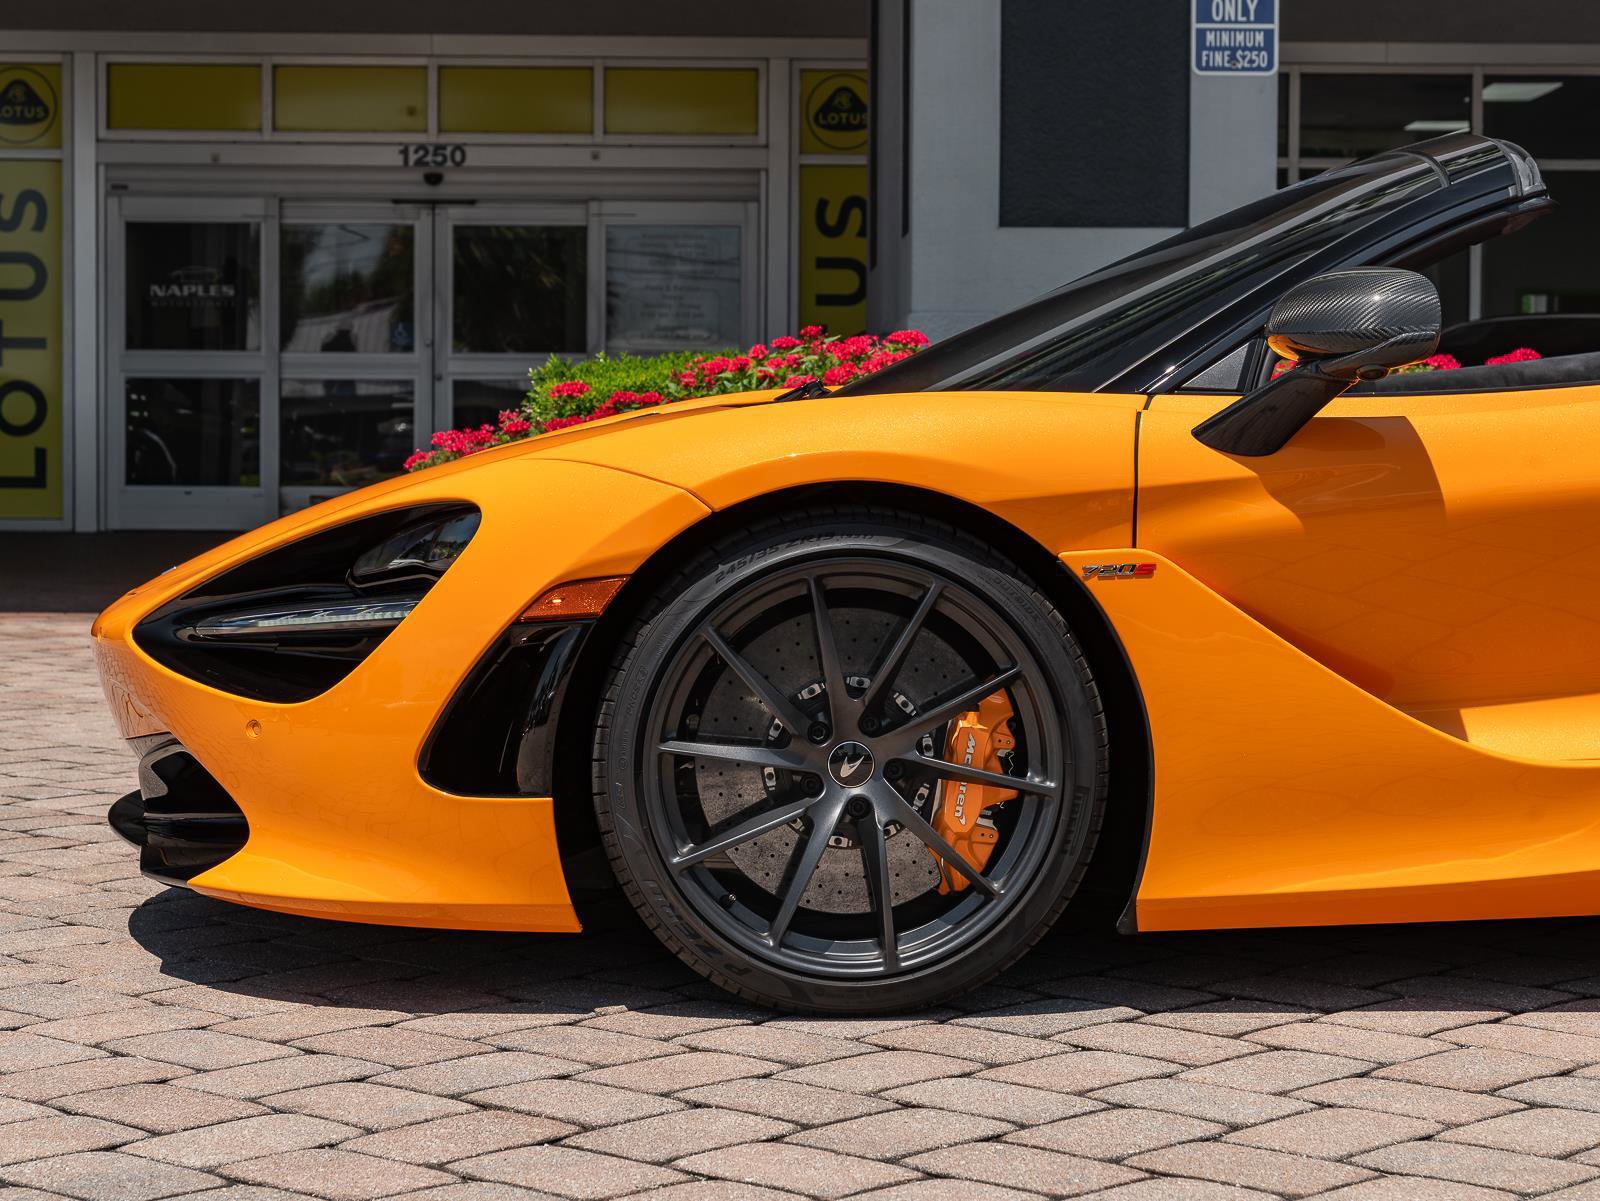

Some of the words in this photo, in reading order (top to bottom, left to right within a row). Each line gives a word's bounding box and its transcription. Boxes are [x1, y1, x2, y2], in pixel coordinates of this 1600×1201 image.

[1211, 0, 1258, 22] ONLY
[1206, 30, 1264, 48] MINIMUM
[1202, 50, 1231, 68] FINE
[1235, 49, 1268, 69] $250
[0, 105, 46, 119] OTUS
[398, 144, 467, 168] 1250
[149, 283, 236, 298] NAPLES
[1081, 562, 1157, 579] 720S
[954, 731, 976, 822] Mcren
